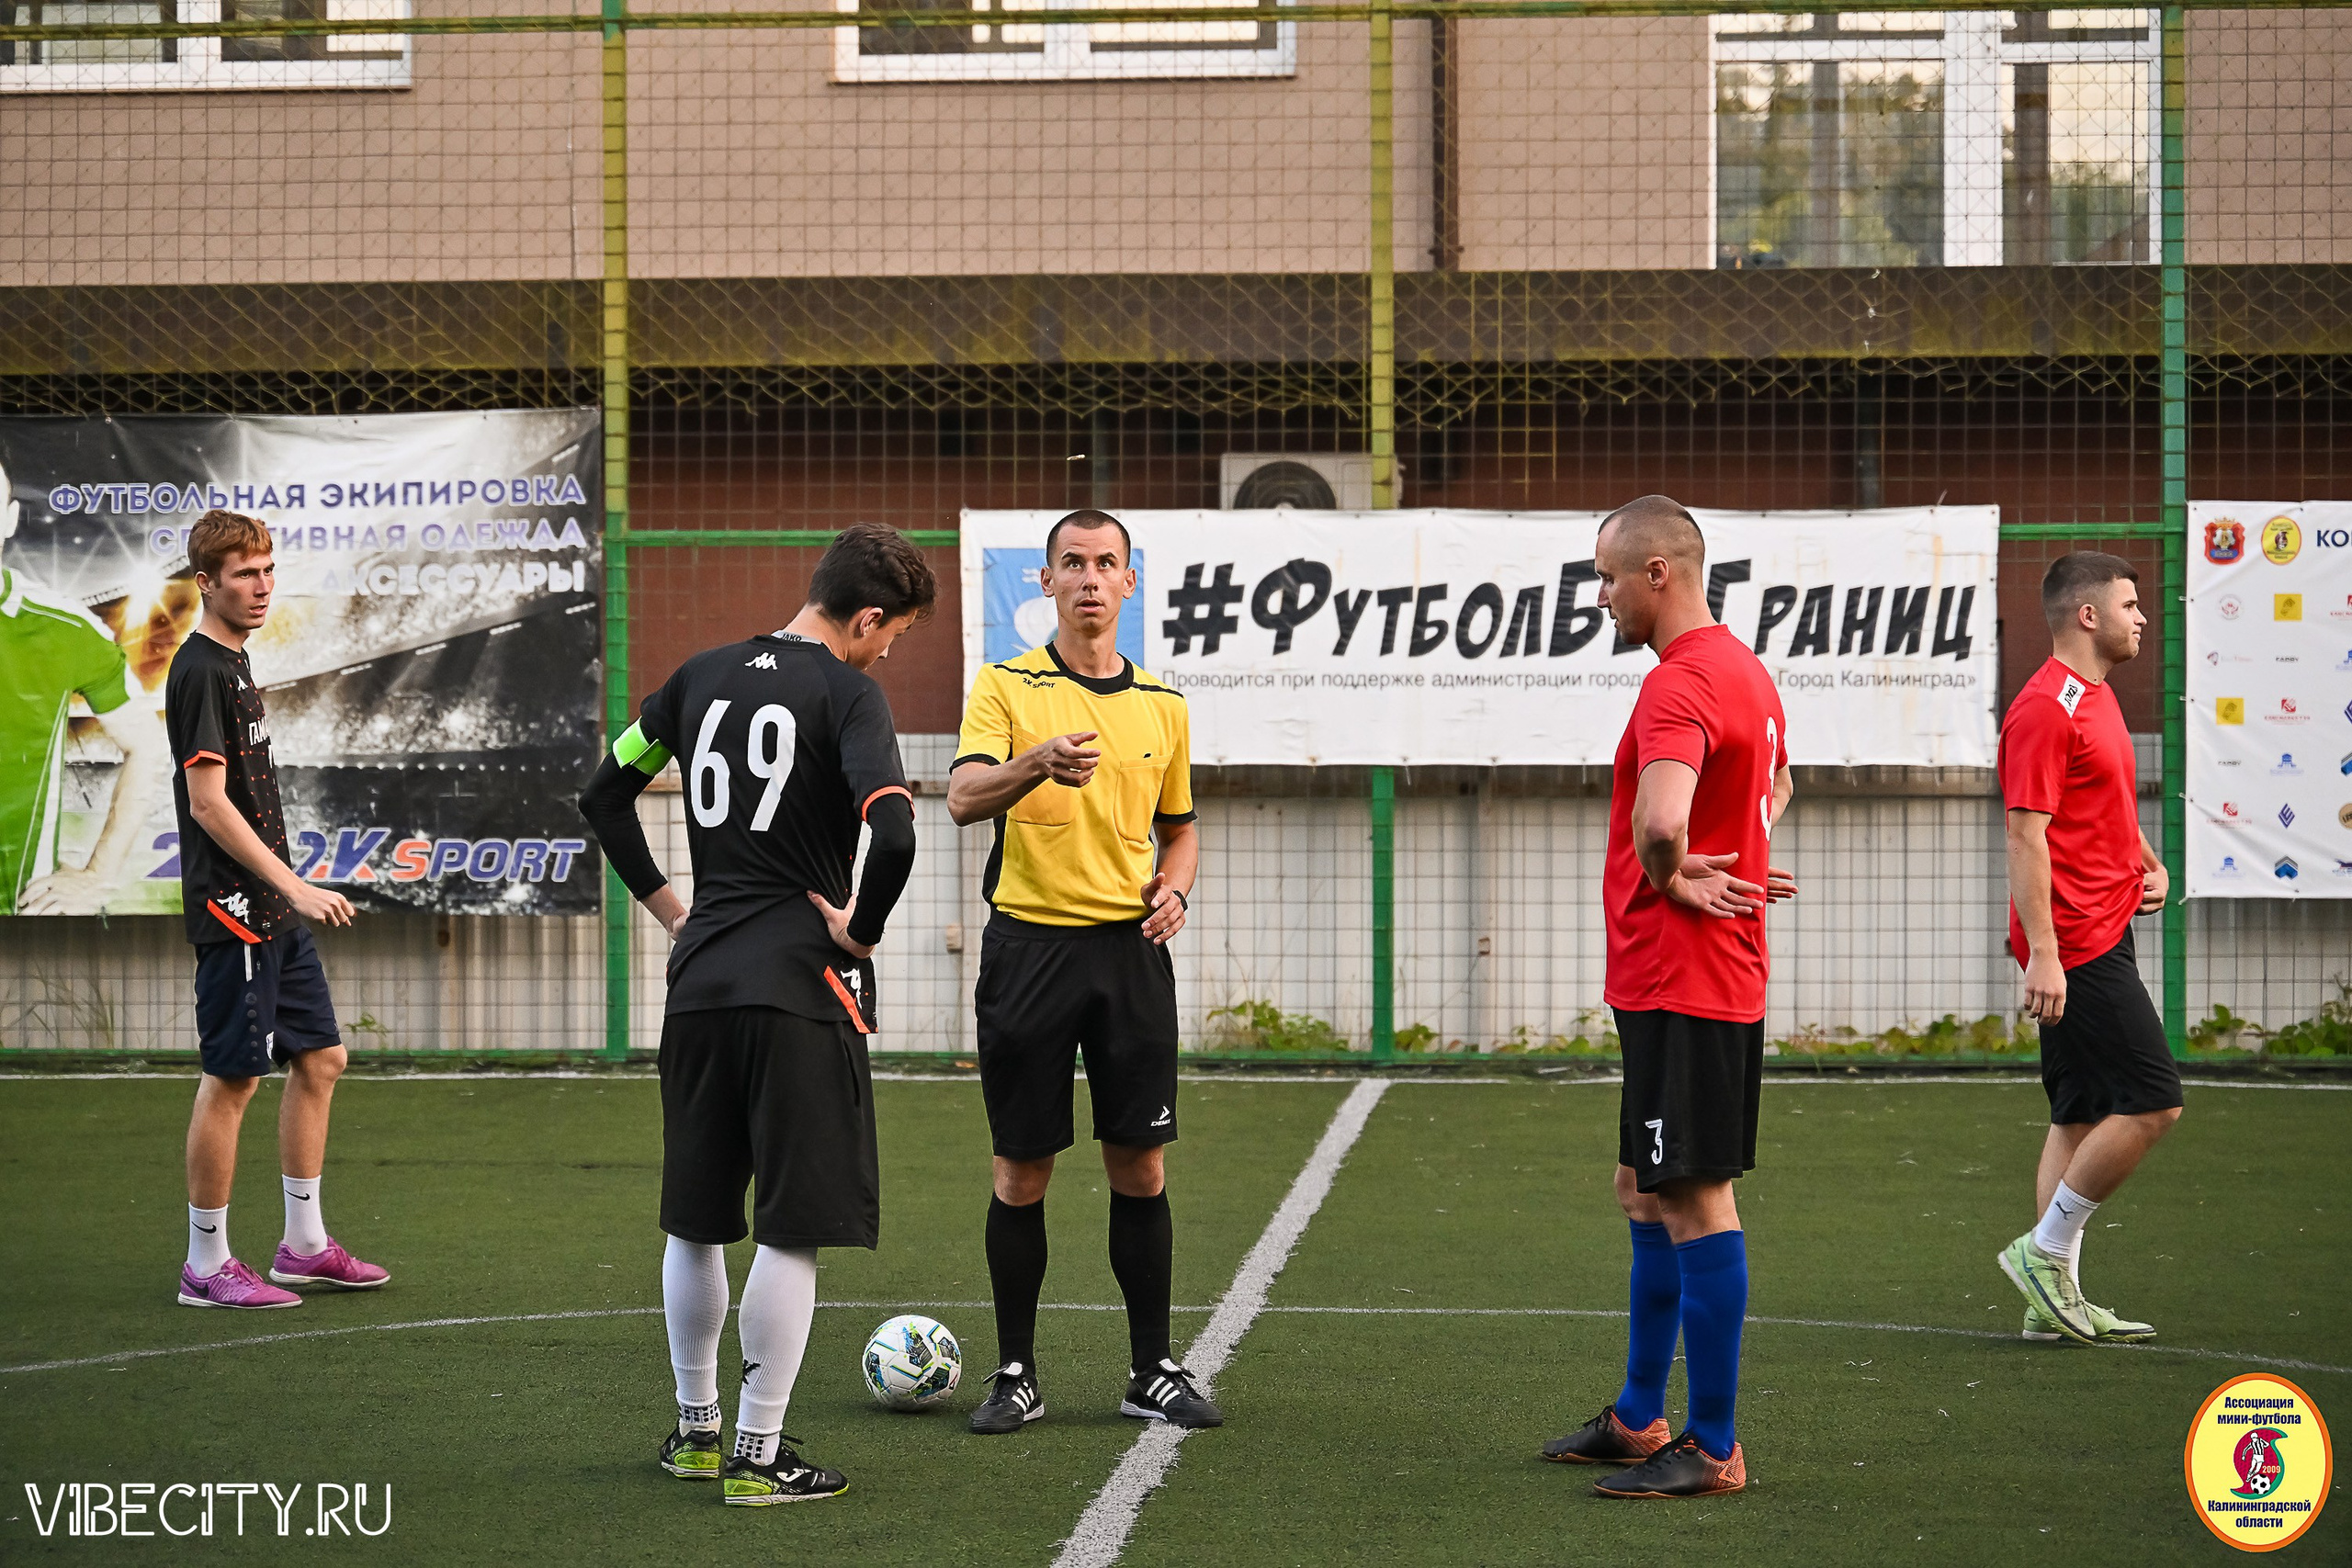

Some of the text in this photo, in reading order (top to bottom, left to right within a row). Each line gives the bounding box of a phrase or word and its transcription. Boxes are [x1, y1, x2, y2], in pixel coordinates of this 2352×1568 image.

[49, 474, 586, 513] ФУТБОЛЬНАЯ ЭКИПИРОВКА
[420, 516, 586, 551] ОДЕЖДА
[2317, 529, 2352, 547] КО
[1162, 670, 1274, 691] Проводится
[1282, 673, 1314, 691] при
[1322, 673, 1424, 691] поддержке
[1431, 673, 1582, 691] администрации
[1841, 671, 1975, 691] Калининград»
[690, 699, 796, 831] 69
[390, 837, 586, 884] SPORT
[1645, 1119, 1664, 1165] 3
